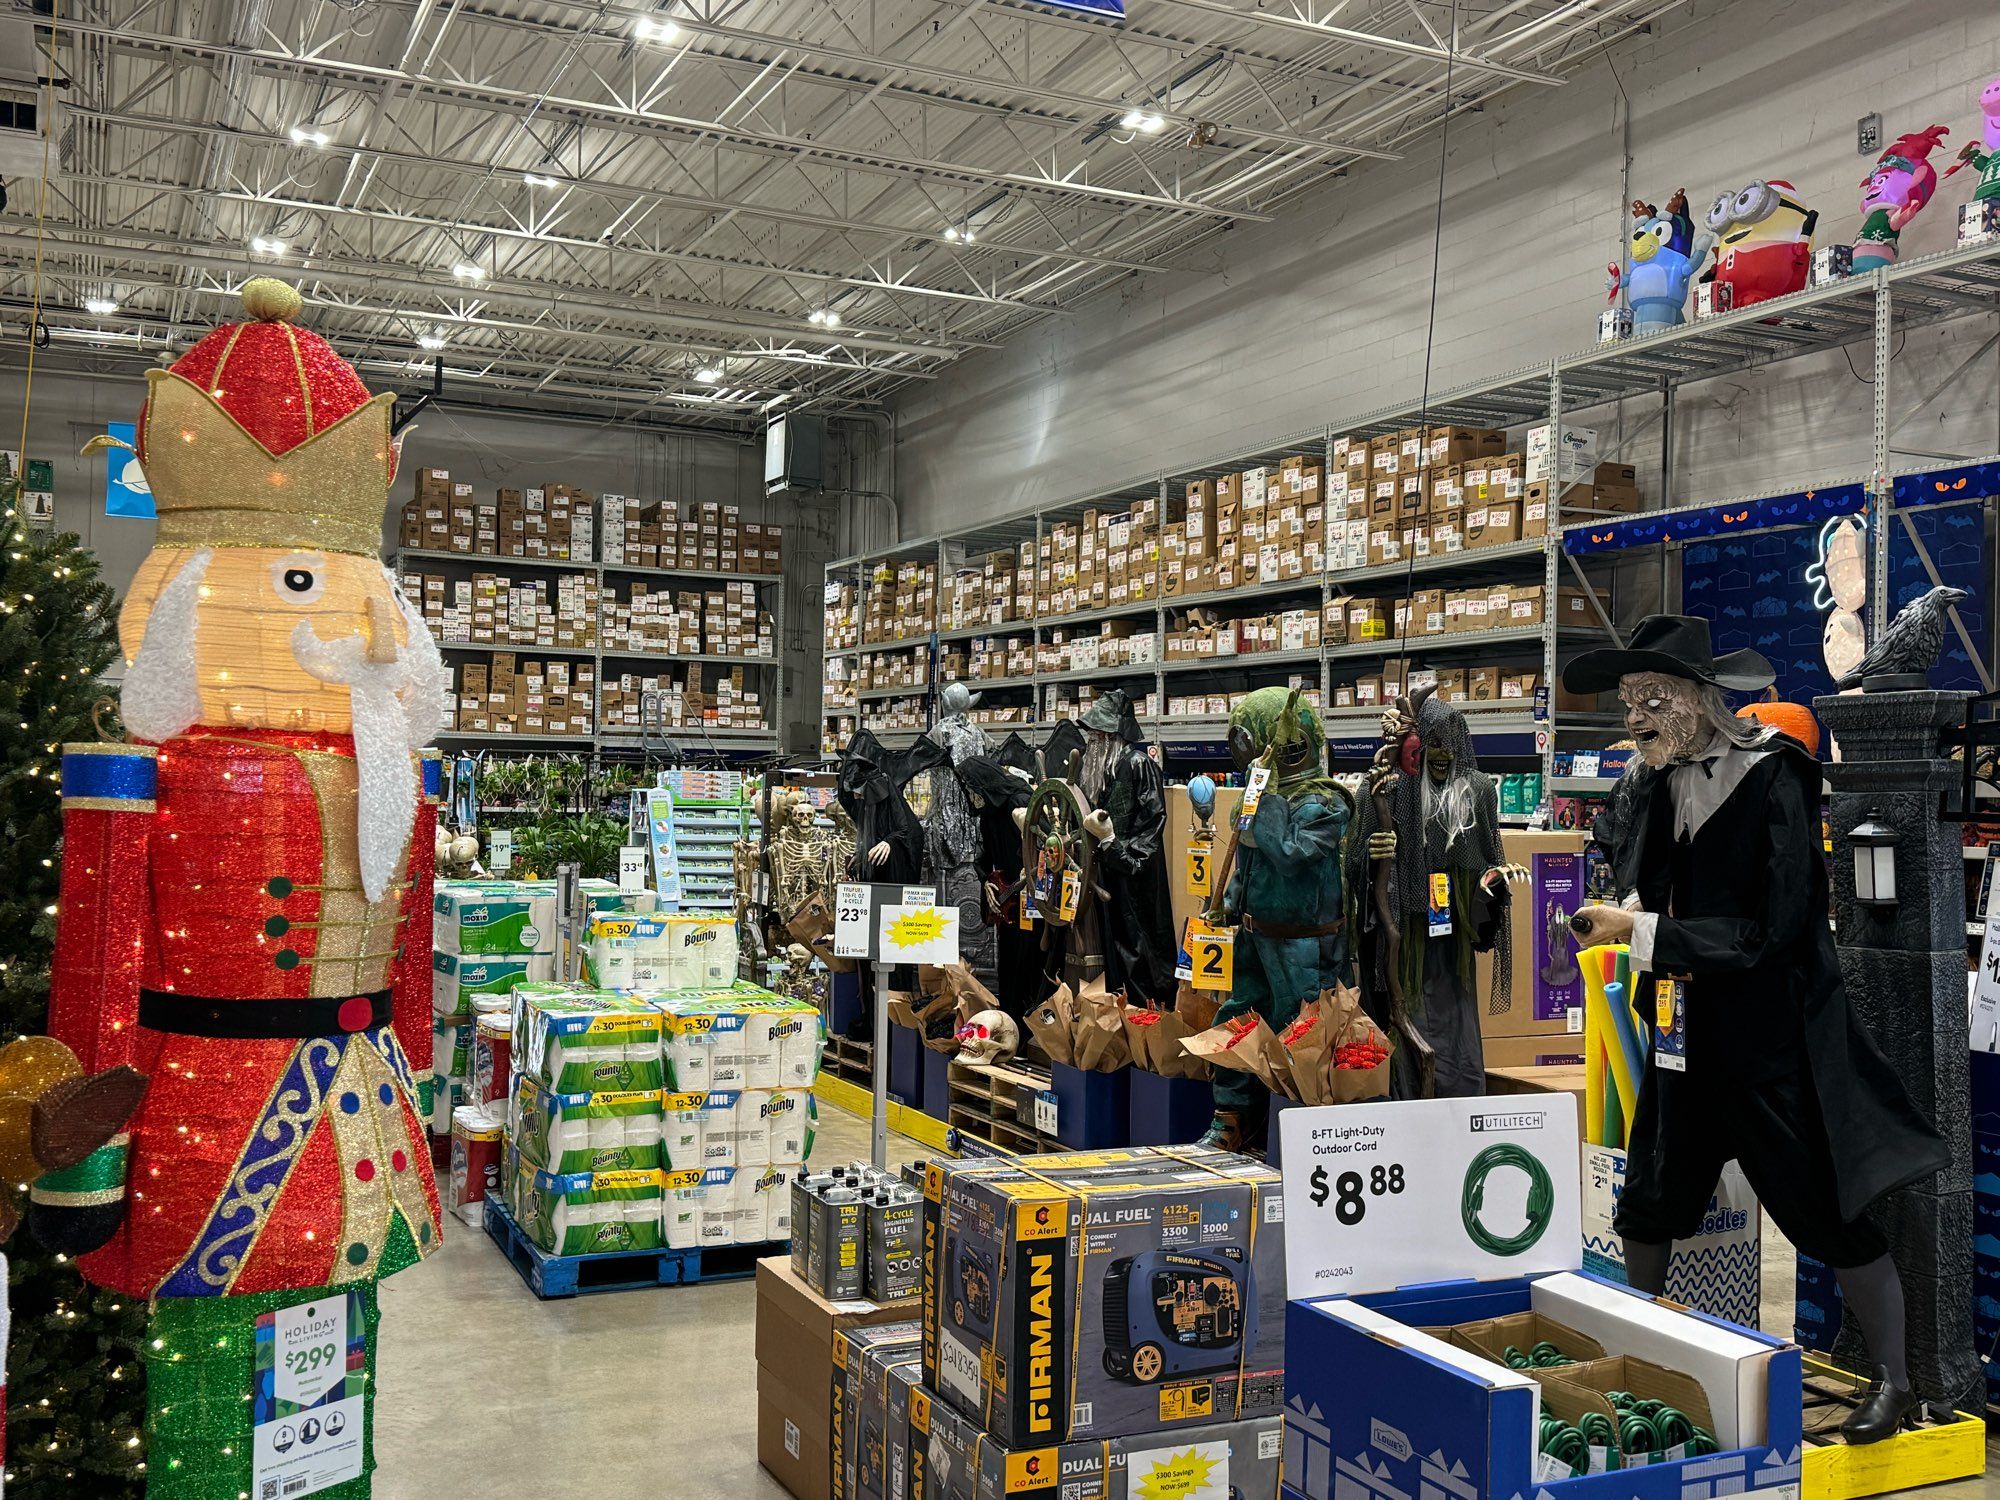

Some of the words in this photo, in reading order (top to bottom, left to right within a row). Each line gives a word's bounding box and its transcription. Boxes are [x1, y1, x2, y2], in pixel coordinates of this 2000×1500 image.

[1602, 760, 1628, 768] Hallow
[1192, 855, 1205, 882] 3
[1065, 884, 1074, 908] 2
[463, 914, 488, 922] moxie
[684, 929, 717, 948] Bounty
[1203, 943, 1223, 975] 2
[1987, 950, 2000, 983] $1
[462, 973, 486, 981] moxie
[768, 1020, 803, 1041] Bounty
[760, 1098, 794, 1118] Bounty
[1485, 1116, 1540, 1128] UTILITECH
[1311, 1128, 1333, 1140] 8-FT
[1335, 1126, 1385, 1139] Light-Duty
[1312, 1143, 1352, 1155] Outdoor
[1354, 1141, 1377, 1152] Cord
[592, 1151, 622, 1167] Bounty
[755, 1172, 786, 1193] Bounty
[943, 1185, 960, 1202] DAL
[839, 1206, 858, 1214] TRU
[883, 1209, 914, 1221] 4-CYCLE
[1115, 1208, 1152, 1223] FUEL
[1162, 1204, 1189, 1215] 4125
[884, 1225, 908, 1235] FUEL
[1024, 1228, 1036, 1236] CO
[1037, 1226, 1058, 1235] Alert
[1162, 1226, 1188, 1237] 3300
[1202, 1222, 1229, 1234] 3000
[1089, 1233, 1118, 1241] CONNECT
[1166, 1255, 1200, 1266] FIRMAN
[1315, 1266, 1354, 1280] #0242043
[887, 1287, 922, 1299] TRUFU
[925, 1220, 935, 1370] FIRMAN
[285, 1317, 337, 1339] HOLIDAY
[299, 1331, 323, 1343] LIVING
[1029, 1254, 1052, 1434] FIRMAN
[285, 1342, 337, 1375] $299
[1062, 1457, 1103, 1474] DUAL
[1108, 1453, 1127, 1467] FU
[1028, 1476, 1049, 1485] Alert
[1156, 1471, 1172, 1480] $300
[1172, 1469, 1194, 1478] Savings
[1082, 1480, 1104, 1488] CONNE
